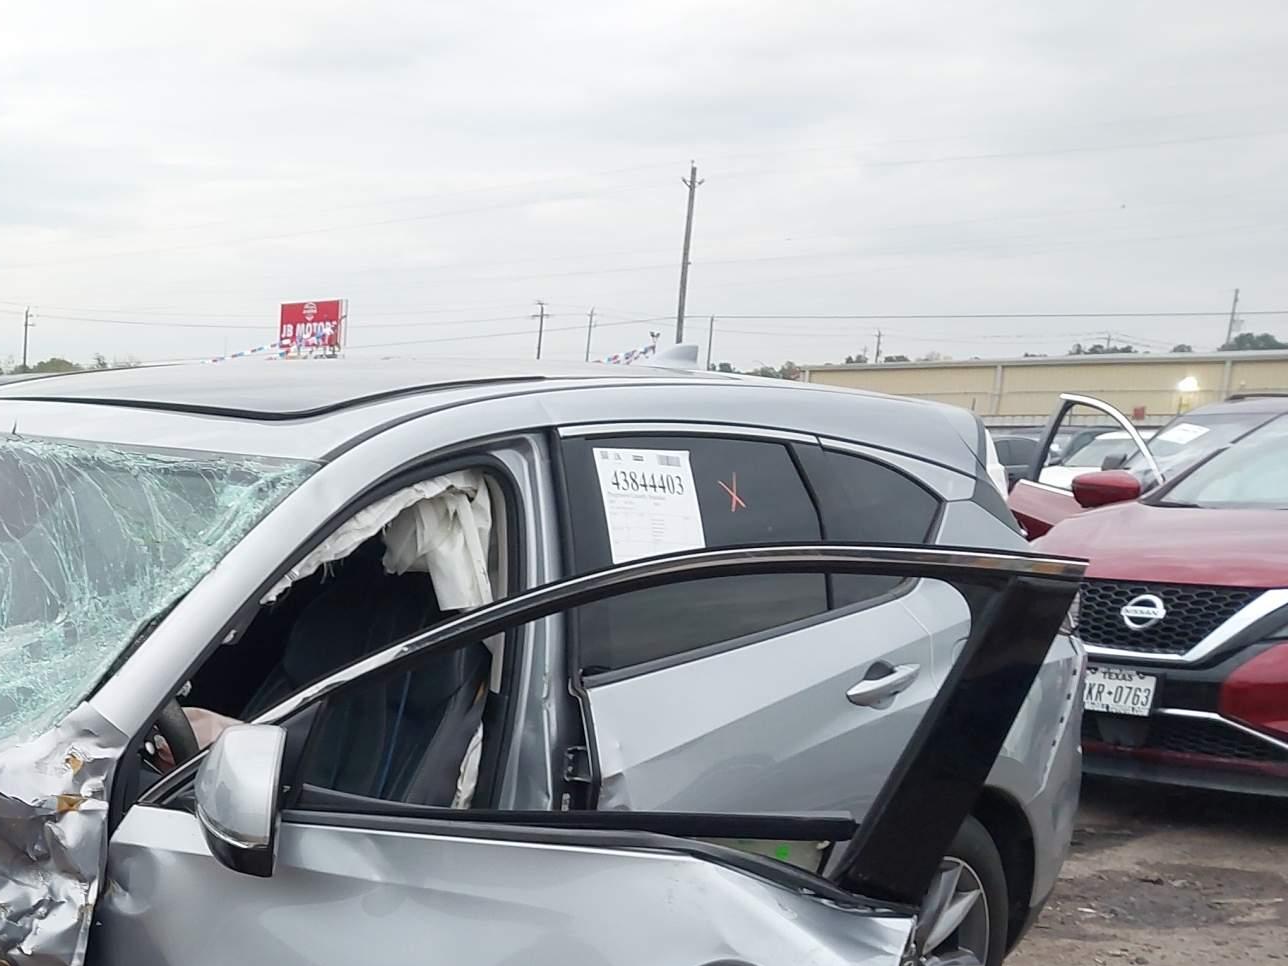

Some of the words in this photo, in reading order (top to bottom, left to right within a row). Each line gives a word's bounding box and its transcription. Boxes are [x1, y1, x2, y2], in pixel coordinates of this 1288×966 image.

[281, 323, 294, 338] JB
[611, 469, 685, 495] 43844403
[1101, 671, 1134, 682] TEXAS
